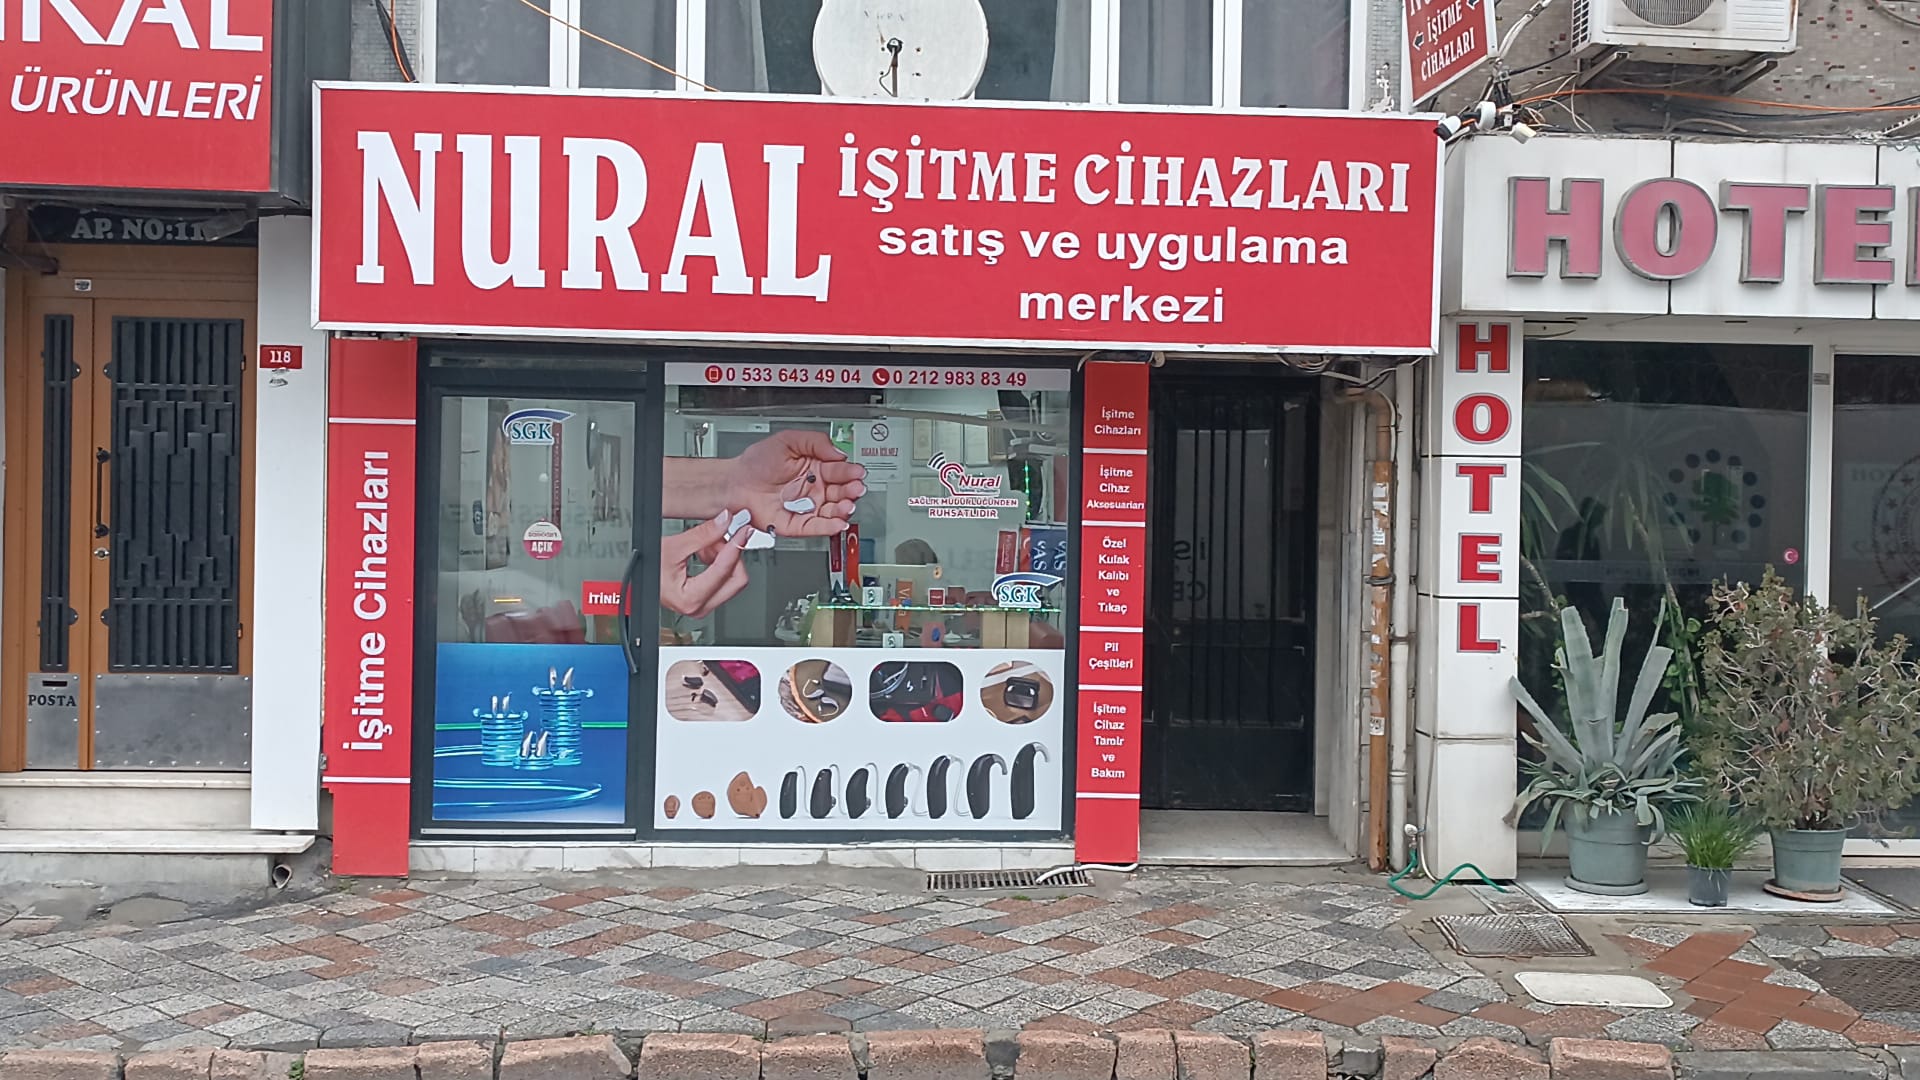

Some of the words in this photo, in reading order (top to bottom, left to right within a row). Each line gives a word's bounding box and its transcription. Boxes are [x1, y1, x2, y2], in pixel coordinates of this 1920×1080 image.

[1426, 0, 1463, 45] İŞİTME
[1421, 27, 1475, 81] CİHAZLARI
[10, 66, 263, 120] ÜRÜNLERİ
[839, 133, 1056, 212] İŞİTME
[1074, 141, 1409, 213] CİHAZLARI
[356, 131, 831, 301] NURAL
[1507, 177, 1920, 284] HOTE
[879, 226, 1004, 264] satış
[1020, 231, 1079, 258] ve
[1098, 227, 1348, 271] uygulama
[1020, 286, 1223, 322] merkezi
[270, 350, 291, 363] 118
[726, 368, 736, 383] 0
[742, 369, 773, 384] 533
[778, 369, 809, 383] 643
[814, 370, 835, 383] 49
[841, 370, 862, 384] 04
[893, 370, 902, 384] 0
[909, 370, 939, 384] 212
[945, 371, 975, 385] 983
[980, 371, 1001, 385] 83
[1006, 372, 1026, 386] 49
[1102, 406, 1135, 420] İşitme
[1094, 424, 1141, 436] Cihazları
[1100, 464, 1133, 478] İşitme
[958, 474, 1001, 487] Nural
[1099, 482, 1130, 493] Cihaz
[1454, 322, 1511, 653] HOTEL
[1086, 499, 1145, 510] Aksesuarları
[929, 508, 998, 518] RUHSATLIDIR
[353, 451, 389, 620] Cihazları
[1102, 535, 1127, 549] Özel
[531, 541, 554, 554] AÇIK
[1098, 554, 1130, 565] Kulak
[1098, 570, 1129, 581] Kalıbı
[1106, 588, 1120, 597] ve
[1097, 602, 1128, 615] Tıkaç
[1104, 642, 1119, 652] Pil
[1088, 657, 1134, 670] Çeşitleri
[343, 632, 392, 750] İşitme
[28, 694, 77, 707] POSTA
[1093, 701, 1127, 716] İşitme
[1094, 719, 1125, 730] Cihaz
[1093, 735, 1125, 746] Tamir
[1101, 753, 1116, 762] ve
[1091, 767, 1125, 778] Bakım
